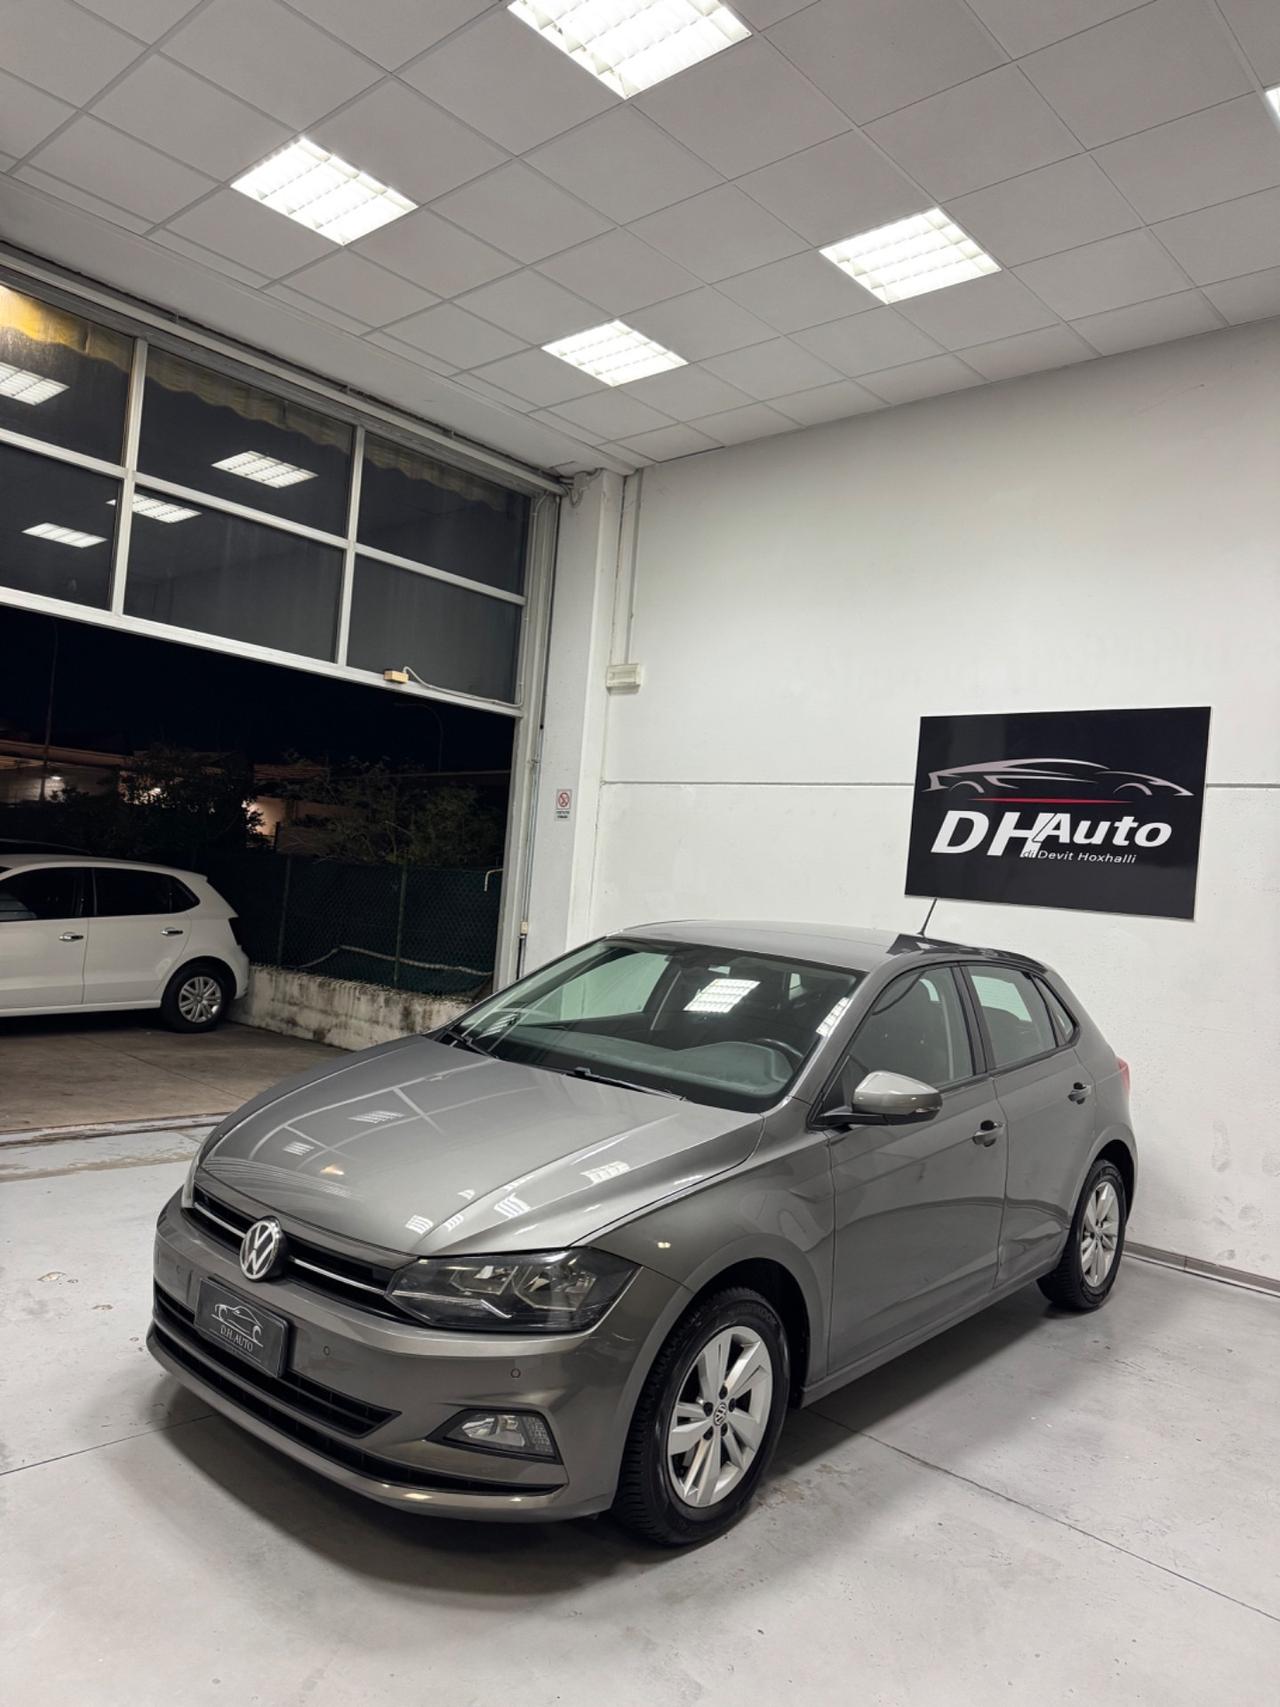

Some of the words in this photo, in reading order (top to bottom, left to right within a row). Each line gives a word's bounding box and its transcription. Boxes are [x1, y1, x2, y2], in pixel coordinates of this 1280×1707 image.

[1032, 813, 1173, 847] Auto
[1037, 850, 1074, 861] Devit
[1077, 852, 1137, 863] Hoxhalli
[234, 1336, 253, 1352] AUTO
